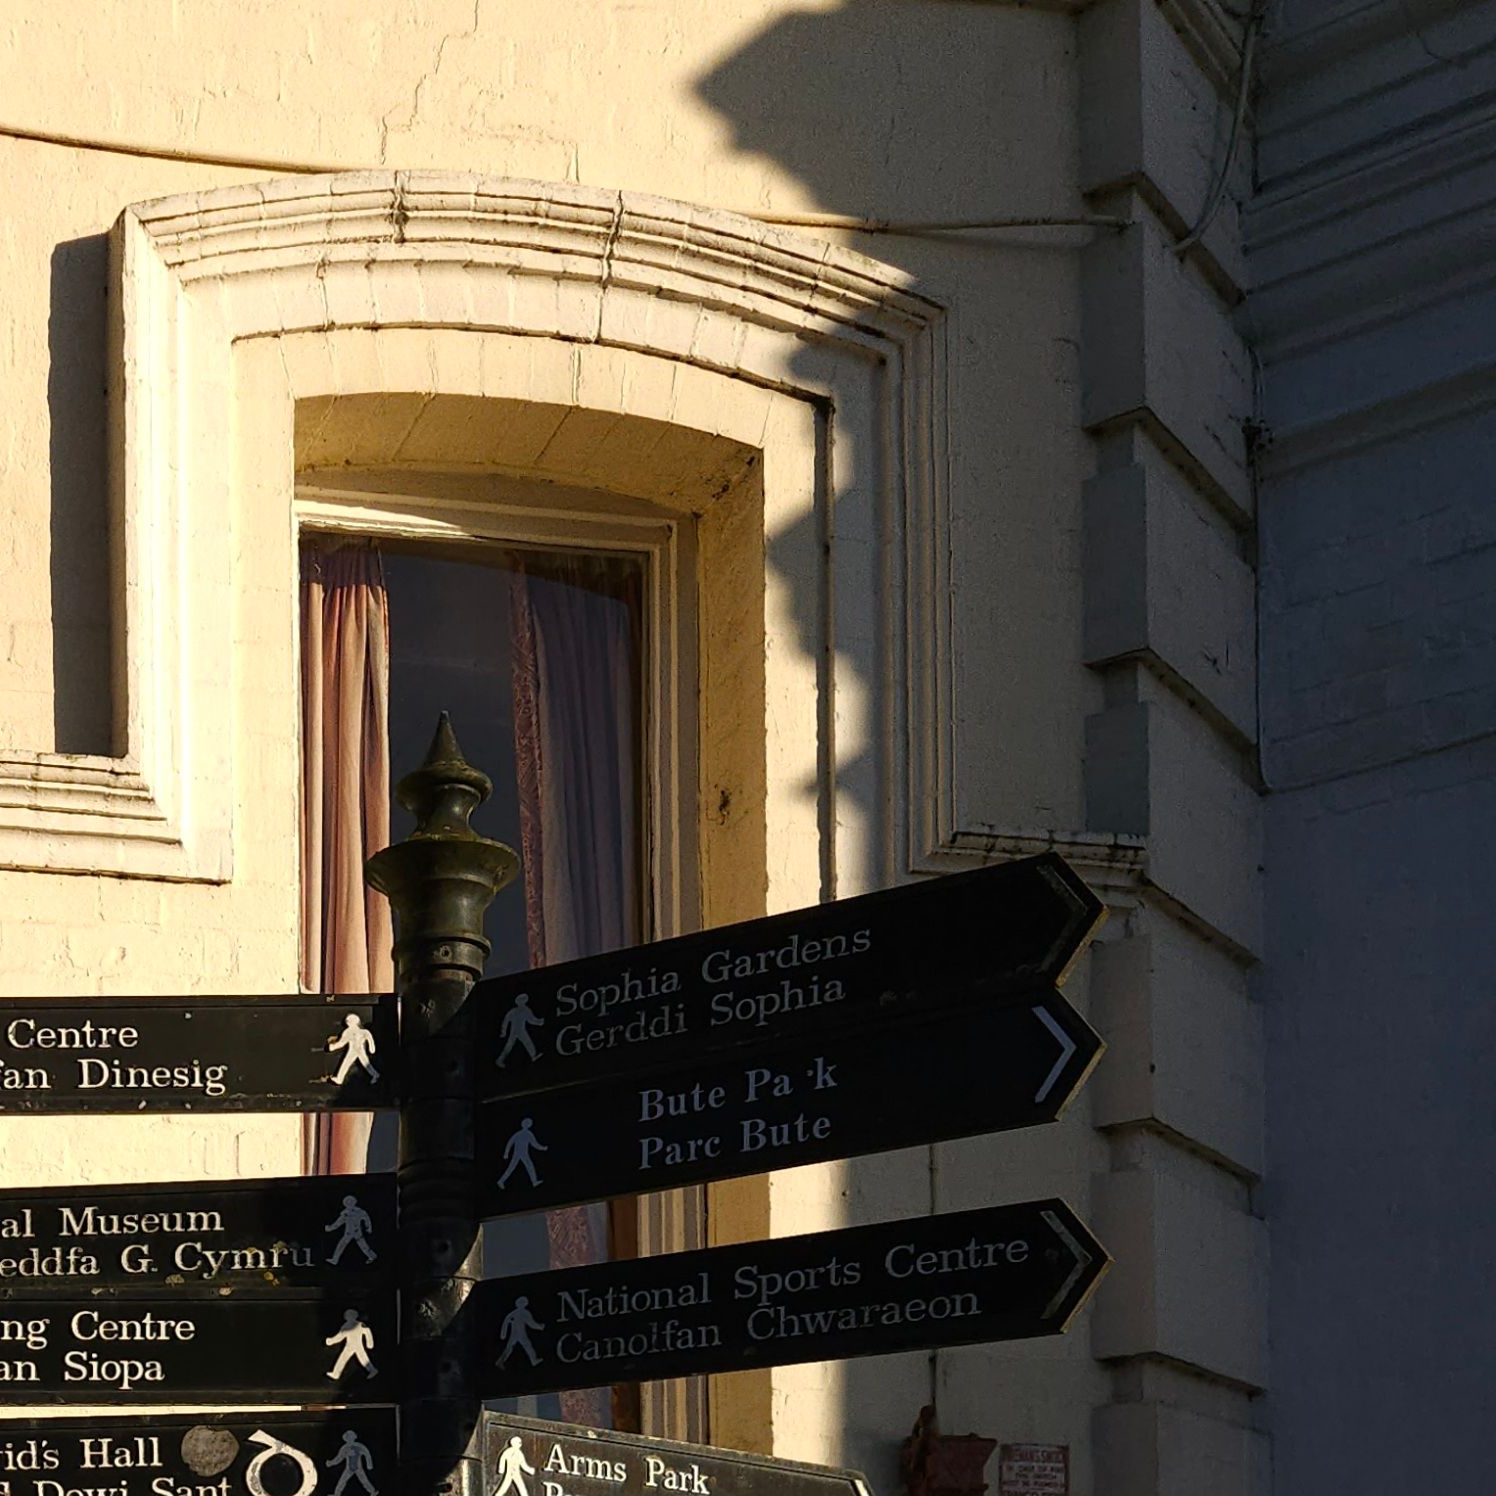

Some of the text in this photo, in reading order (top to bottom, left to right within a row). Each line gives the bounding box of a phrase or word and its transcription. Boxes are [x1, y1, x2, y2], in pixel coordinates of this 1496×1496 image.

[556, 928, 872, 1016] Sophia Gardens
[8, 1019, 139, 1049] Centre
[556, 974, 846, 1057] Gerddi Sophia
[78, 1060, 227, 1095] Dinesig
[638, 1056, 838, 1122] Bute Pak
[638, 1113, 832, 1170] Parc Bute
[59, 1206, 224, 1237] Museum
[174, 1241, 315, 1279] Cymru
[557, 1237, 1030, 1323] National Sports Centre
[70, 1310, 195, 1341] Centre
[556, 1288, 981, 1364] Canolfan Chwaraeon
[64, 1352, 165, 1389] Siopa
[81, 1436, 163, 1467] Hall
[544, 1443, 711, 1496] Arms Park
